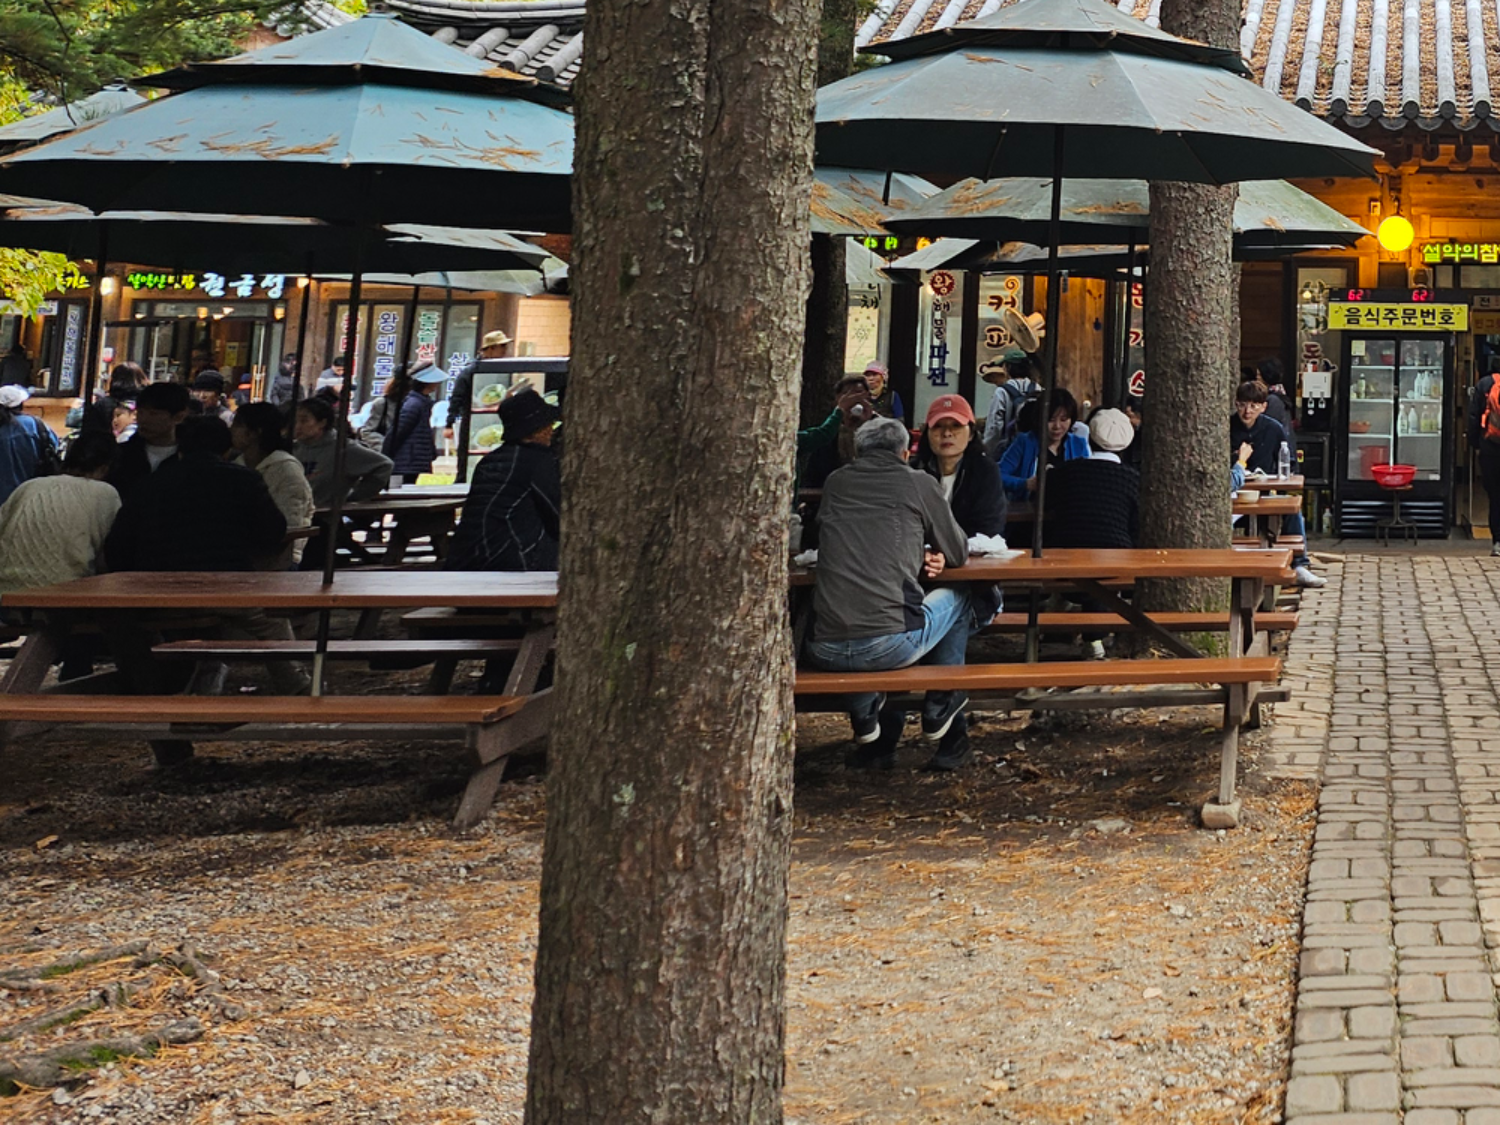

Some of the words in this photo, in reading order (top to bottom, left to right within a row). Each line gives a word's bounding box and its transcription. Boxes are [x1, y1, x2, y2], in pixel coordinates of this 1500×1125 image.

[199, 272, 285, 298] 권금성
[928, 271, 956, 387] 왕해물파전
[1343, 306, 1456, 326] 음식주문번호
